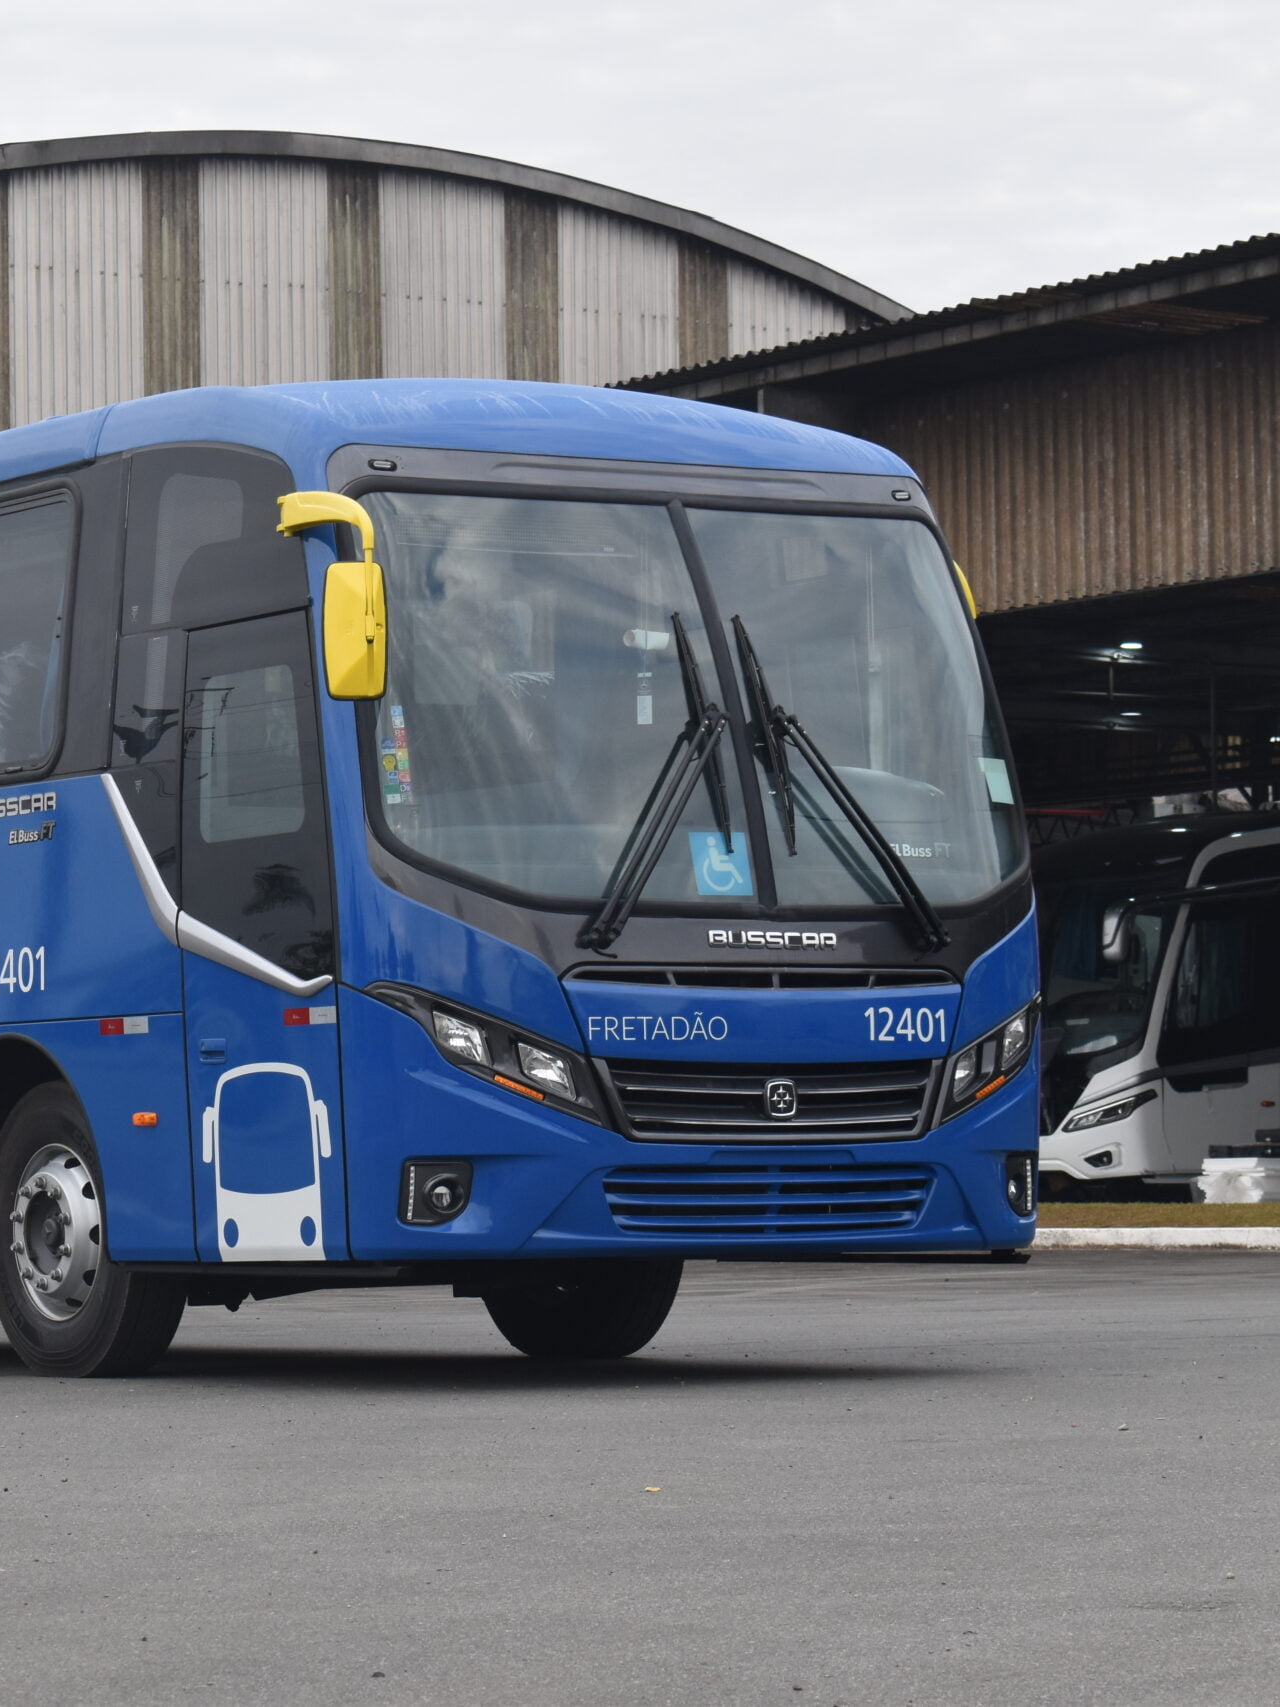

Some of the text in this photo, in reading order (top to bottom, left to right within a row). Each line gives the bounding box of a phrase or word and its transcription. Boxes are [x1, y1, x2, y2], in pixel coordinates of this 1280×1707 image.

[40, 822, 56, 840] FT
[708, 930, 837, 950] BUSSCAR
[588, 1011, 728, 1041] FRETADÃO
[864, 1007, 946, 1042] 12401
